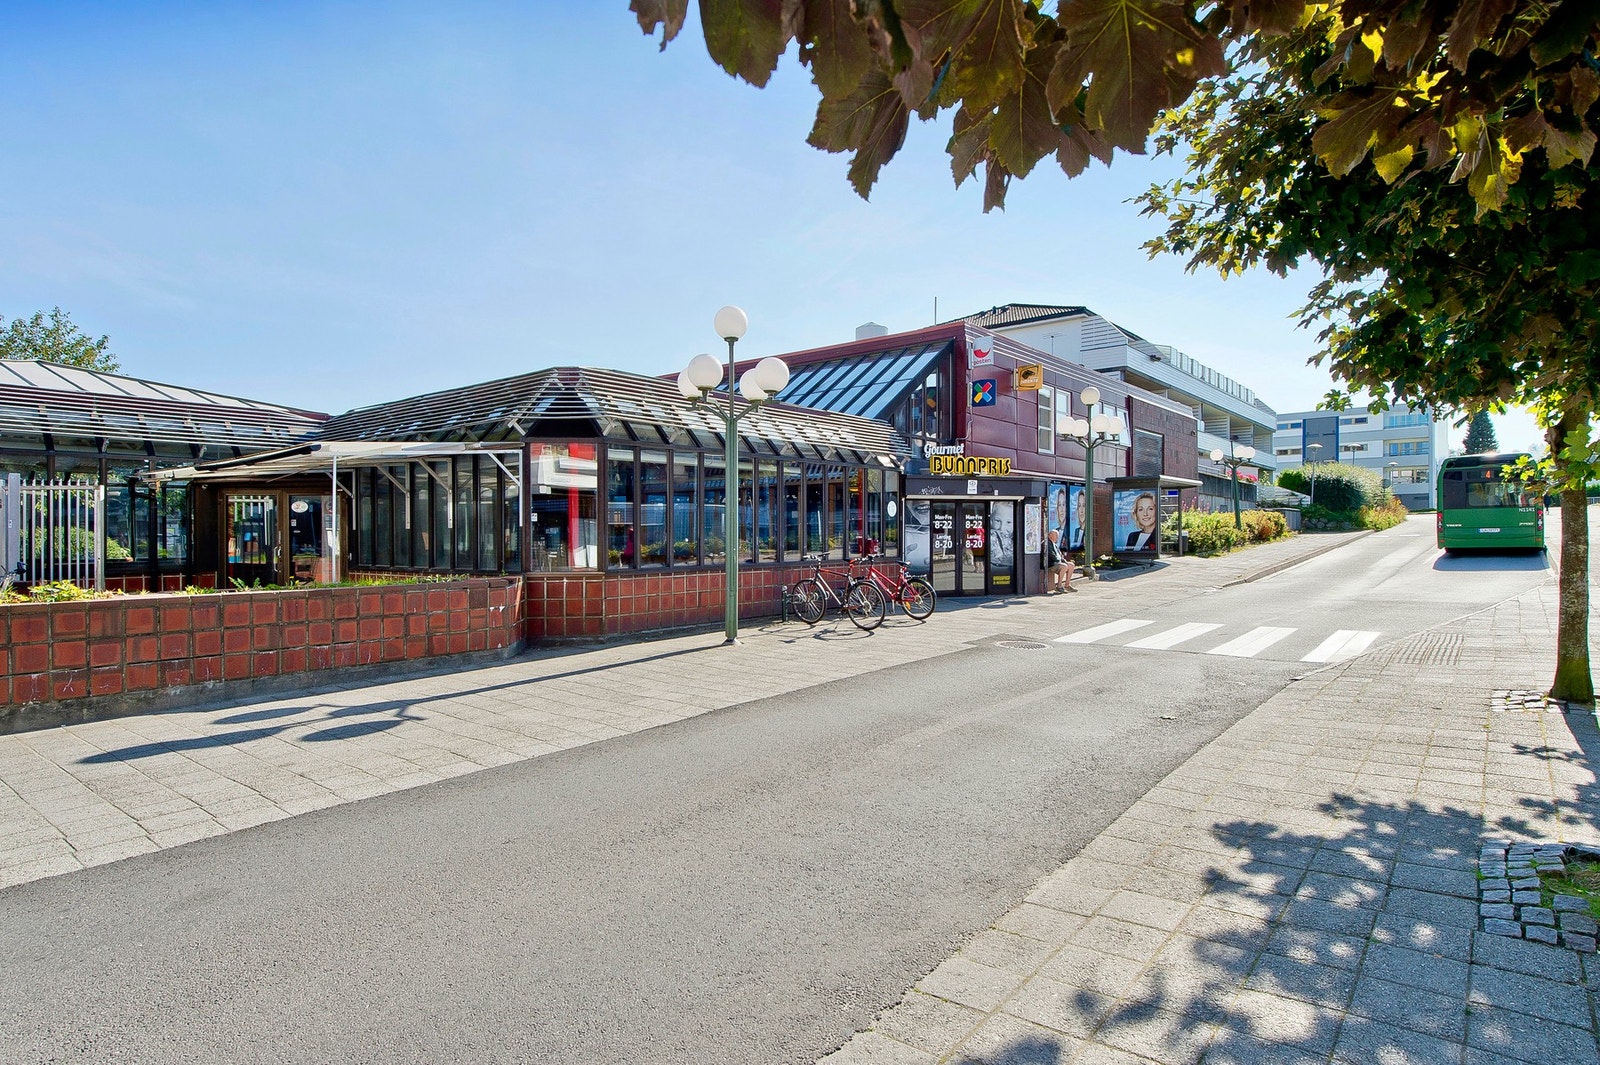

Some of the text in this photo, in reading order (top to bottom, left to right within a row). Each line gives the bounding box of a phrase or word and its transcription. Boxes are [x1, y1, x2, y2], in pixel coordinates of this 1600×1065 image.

[974, 358, 991, 366] posten
[924, 443, 964, 457] Gourmet
[930, 456, 1011, 475] BUNNPRIS
[1485, 470, 1491, 478] 4
[935, 521, 952, 529] 8-22
[965, 521, 983, 529] 8-22
[935, 540, 952, 548] 8-20
[965, 540, 983, 548] 8-20
